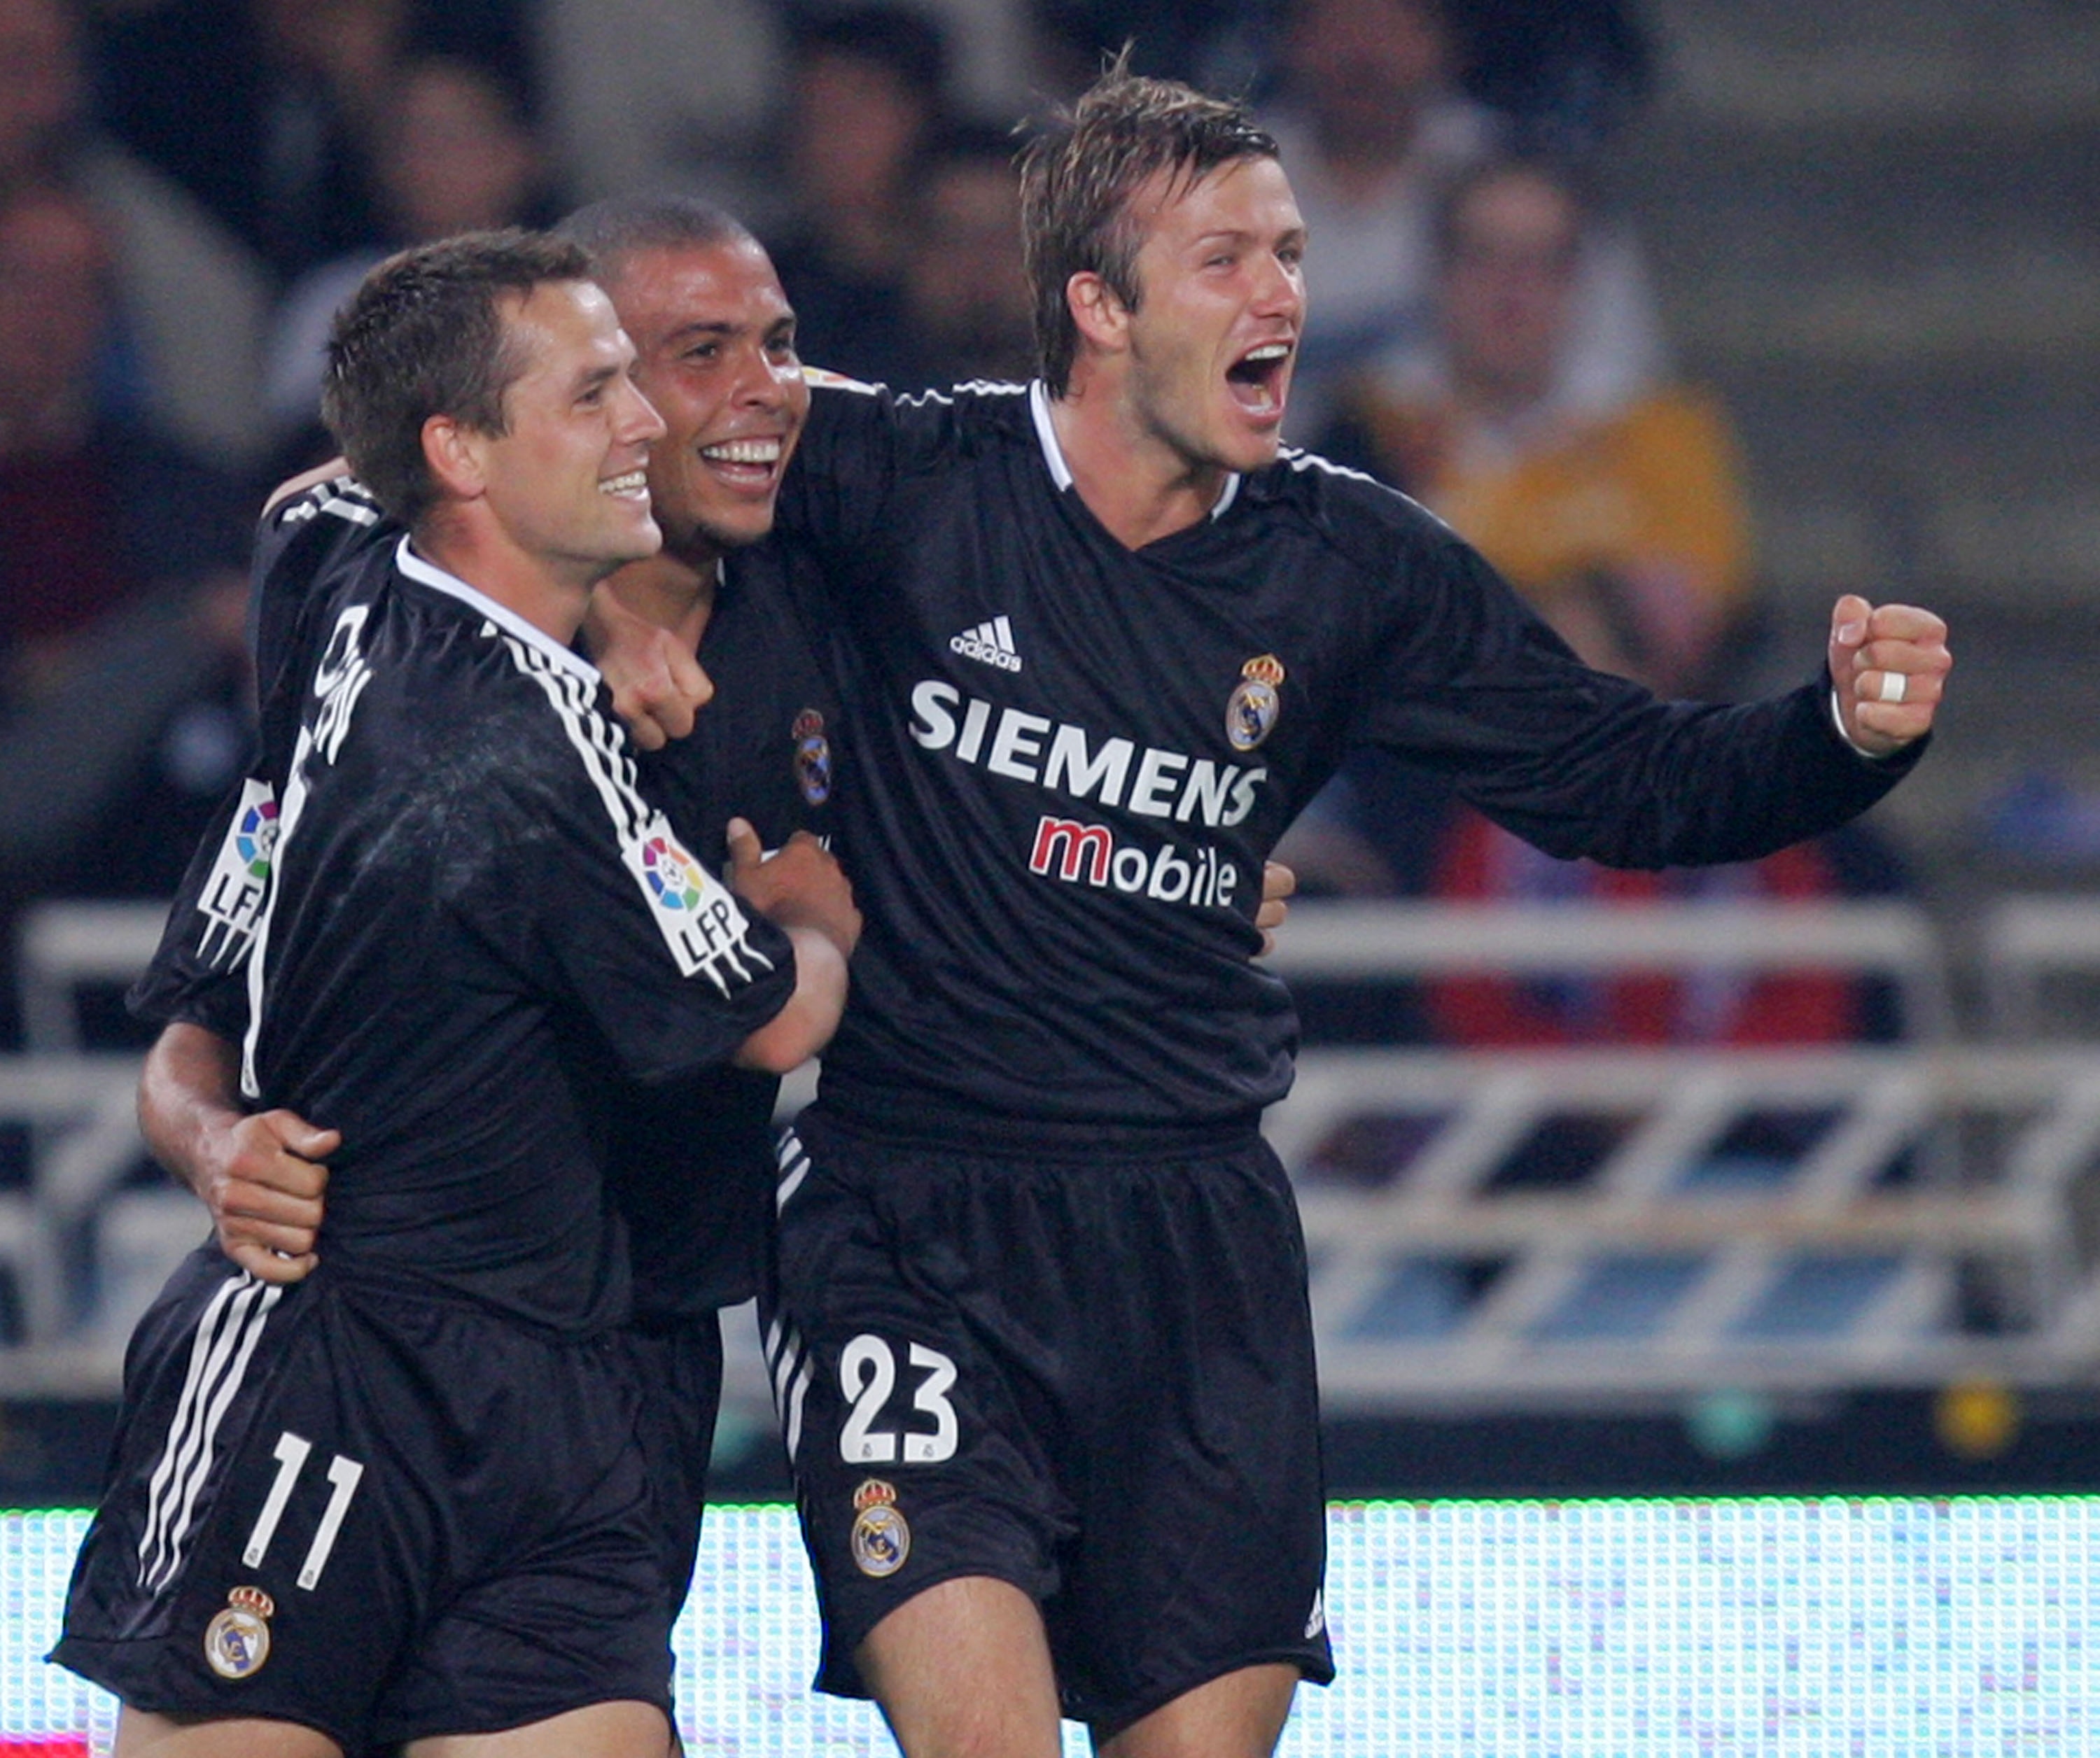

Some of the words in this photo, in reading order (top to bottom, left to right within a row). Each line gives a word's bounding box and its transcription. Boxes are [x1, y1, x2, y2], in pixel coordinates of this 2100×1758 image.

[950, 635, 1022, 673] adidas
[909, 680, 1266, 827] SIEMENS
[1029, 816, 1237, 907] mobile
[679, 899, 733, 966] LFP
[840, 1333, 958, 1464] 23
[241, 1430, 365, 1591] 11
